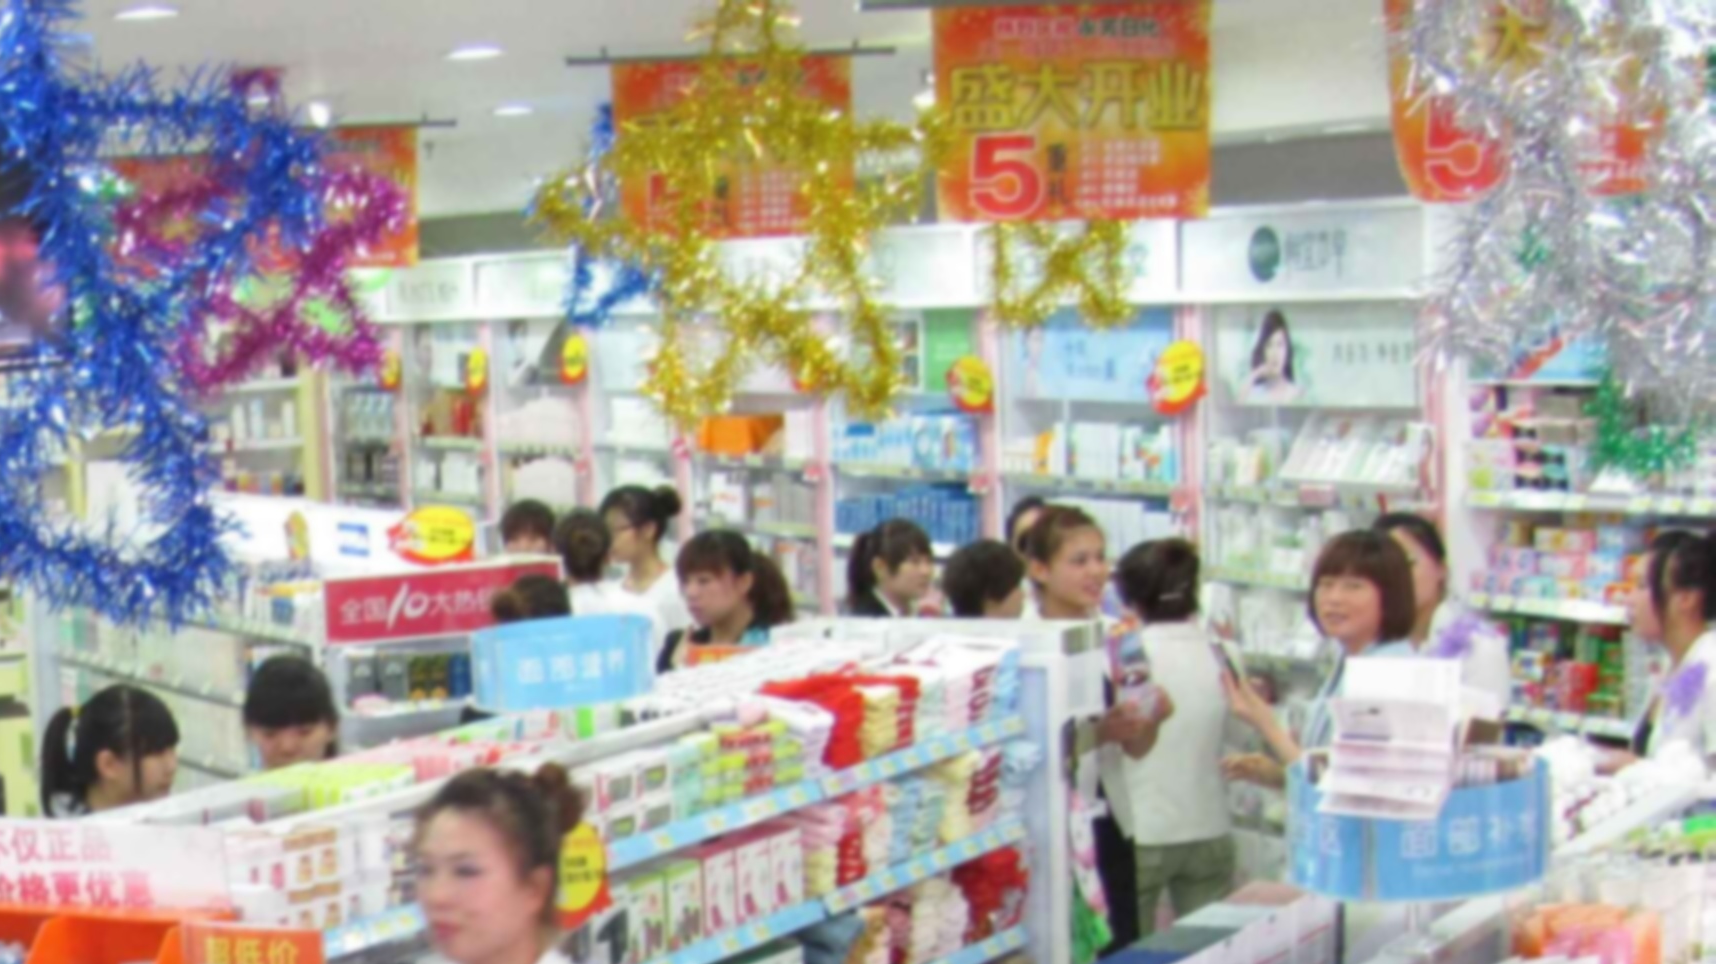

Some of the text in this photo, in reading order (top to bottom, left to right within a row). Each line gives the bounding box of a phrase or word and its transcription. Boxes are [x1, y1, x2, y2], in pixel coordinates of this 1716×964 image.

[950, 62, 1202, 132] 盛大开业
[968, 131, 1045, 220] 5
